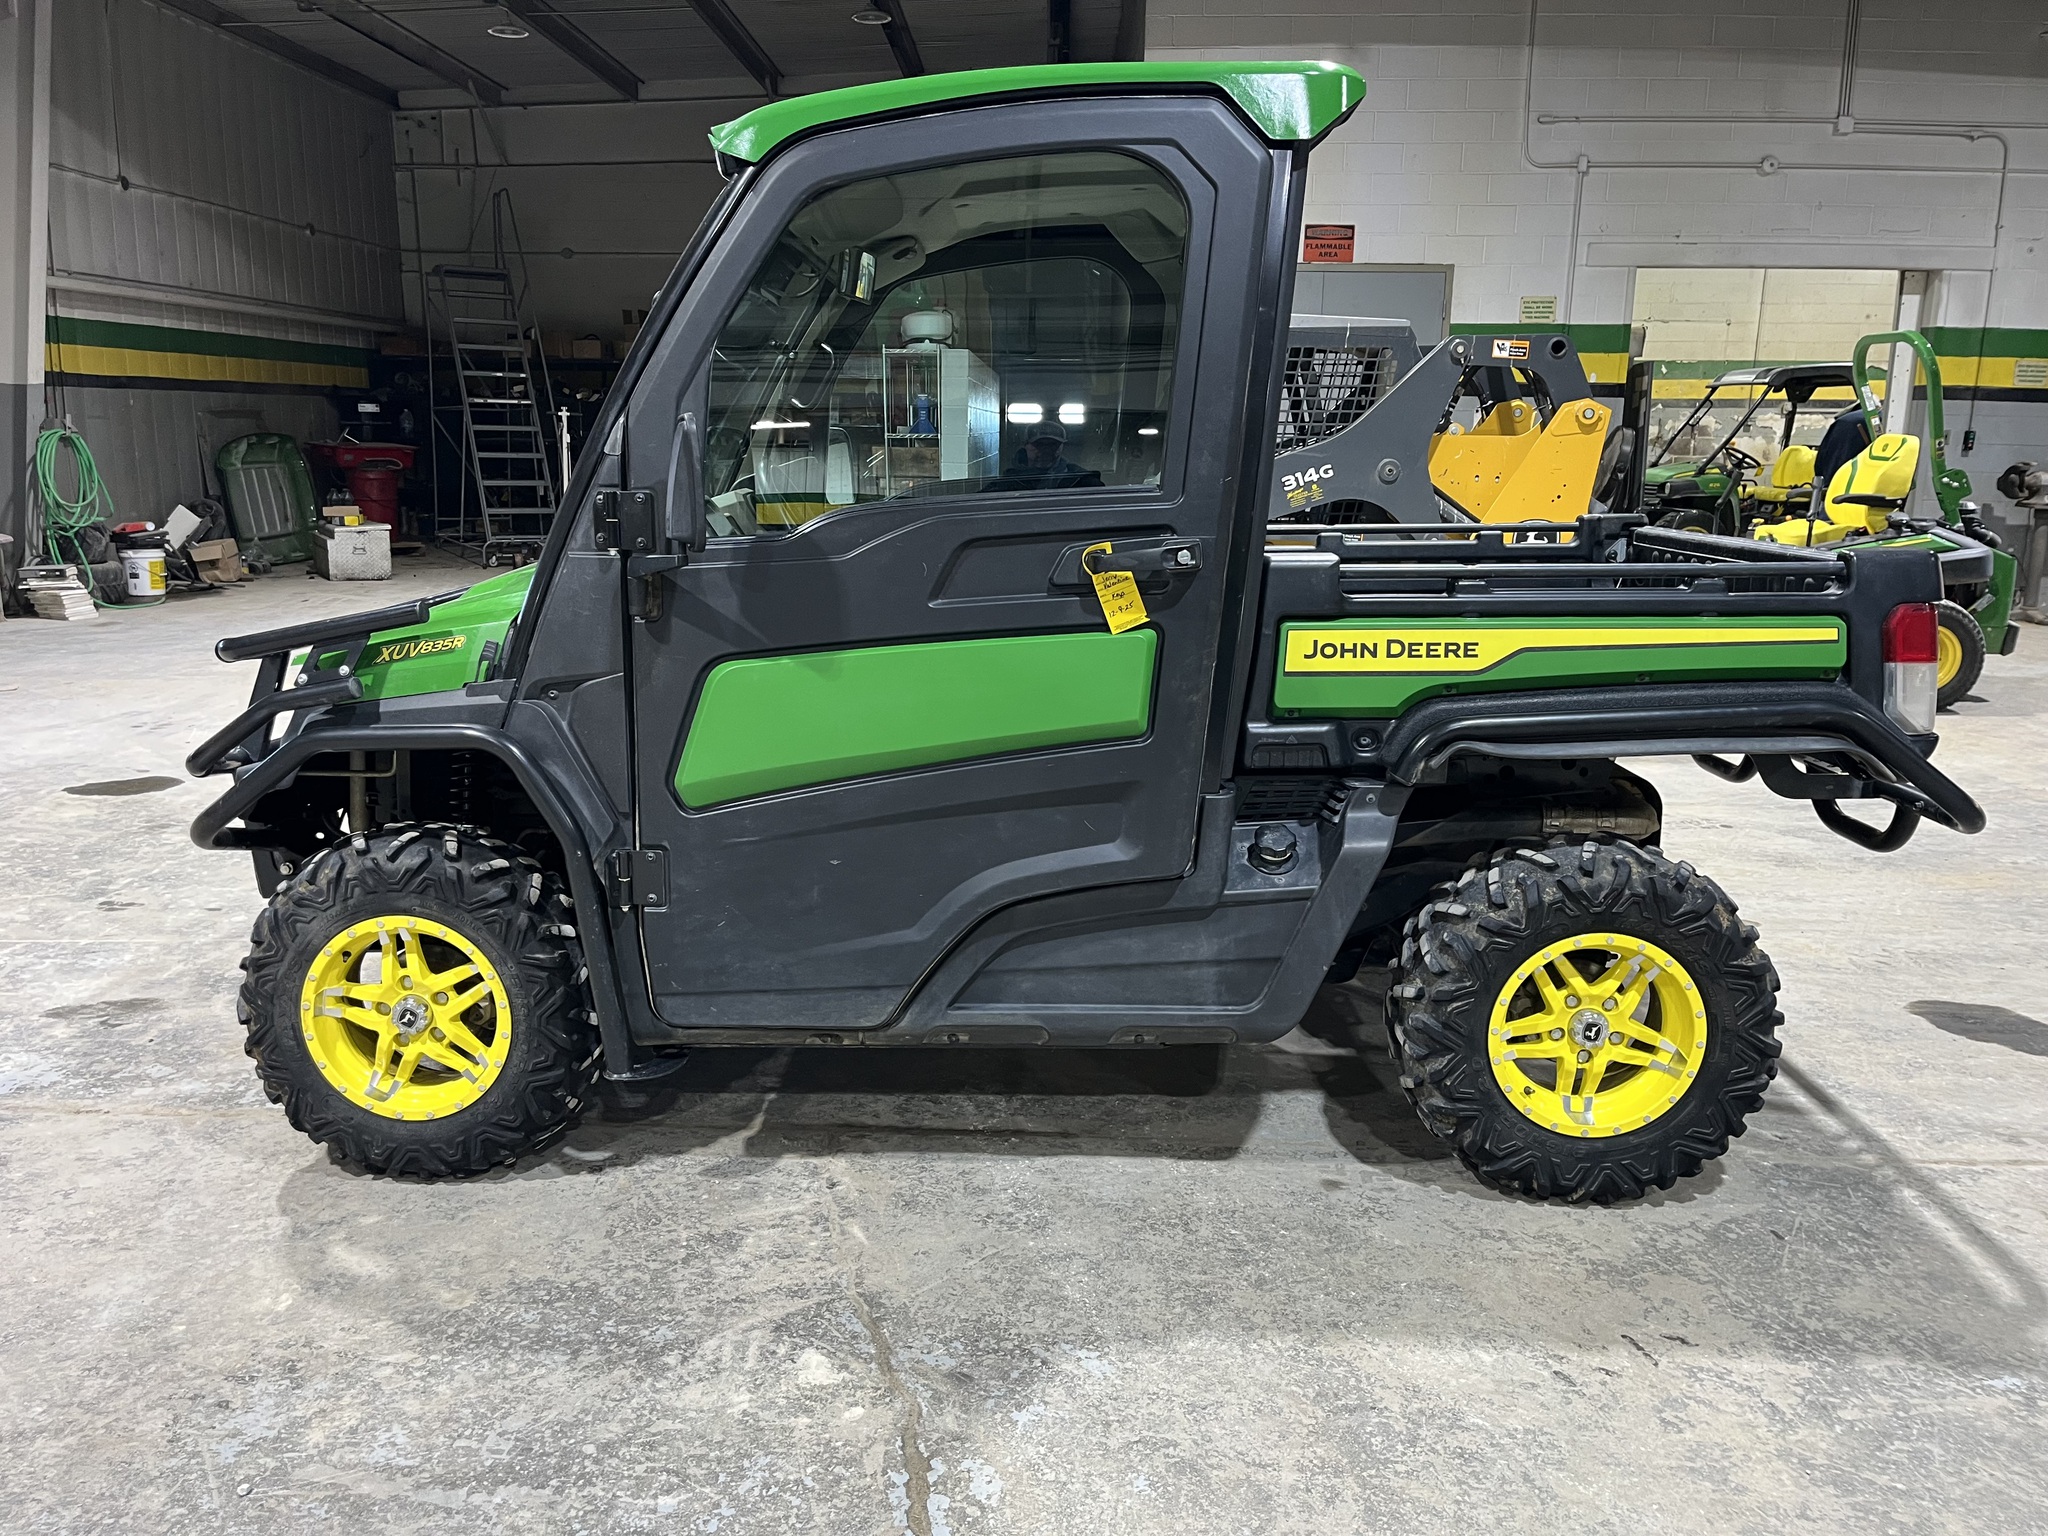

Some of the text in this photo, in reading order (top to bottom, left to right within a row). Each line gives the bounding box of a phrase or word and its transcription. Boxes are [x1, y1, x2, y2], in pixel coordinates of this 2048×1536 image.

[1281, 464, 1334, 491] 314G
[372, 636, 466, 664] XUV835R
[1303, 639, 1479, 659] JOHN DEERE
